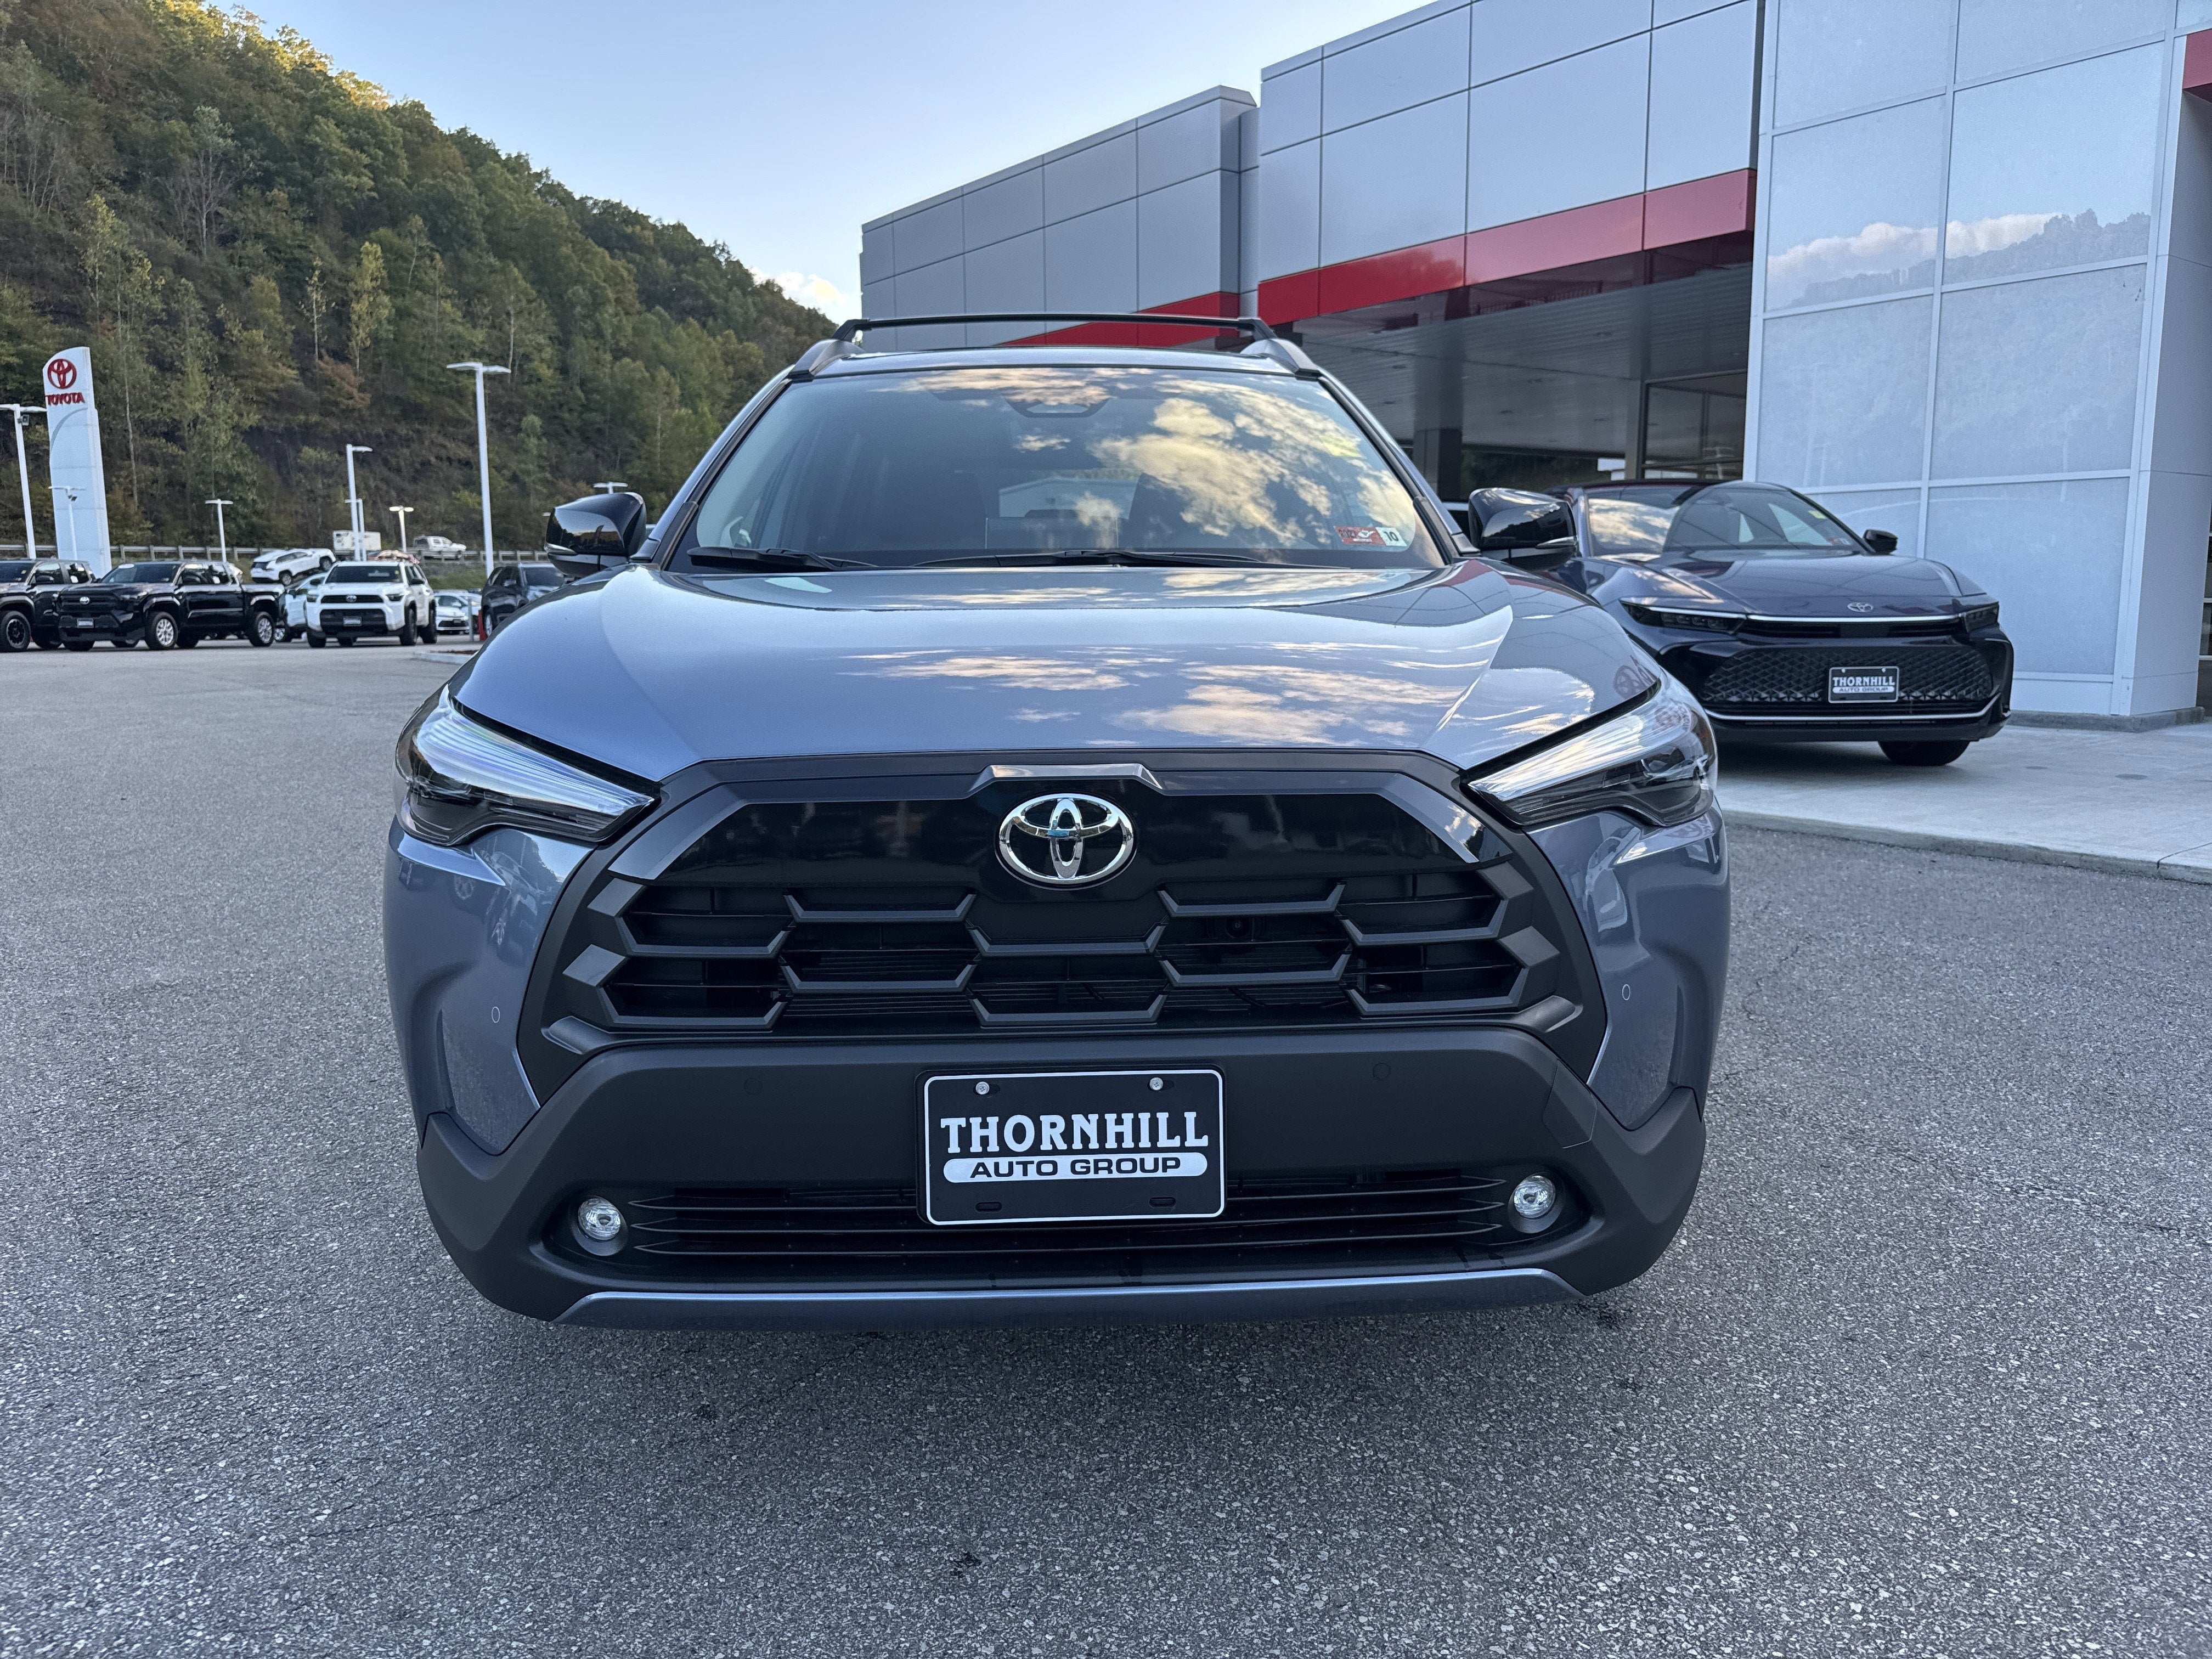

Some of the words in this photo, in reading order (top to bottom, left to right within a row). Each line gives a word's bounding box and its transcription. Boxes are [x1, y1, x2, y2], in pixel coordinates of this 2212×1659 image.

[46, 392, 84, 405] TOYOTA
[1384, 531, 1399, 541] 10
[1832, 675, 1895, 686] THORNHILL
[940, 1111, 1209, 1153] THORNHILL
[970, 1158, 1058, 1178] AUTO
[1070, 1156, 1181, 1176] GROUP
